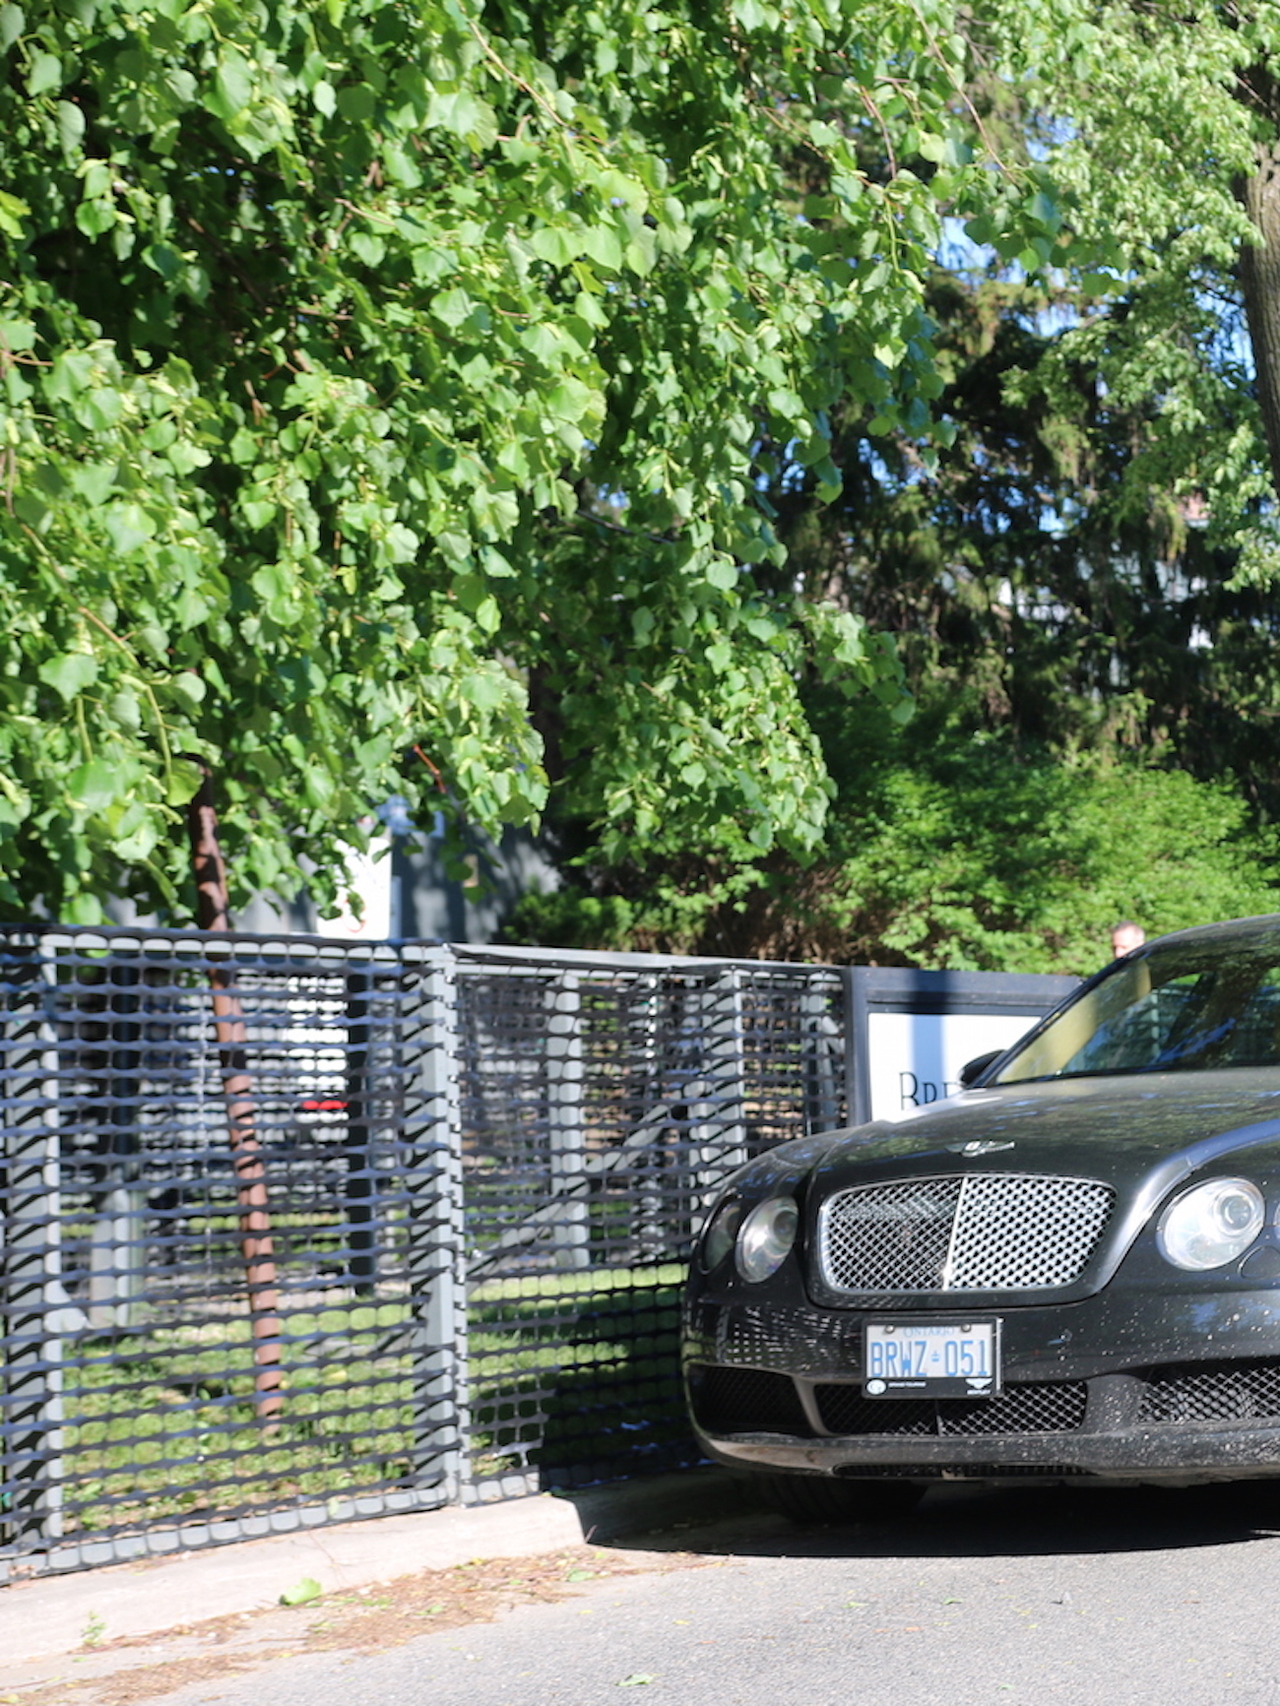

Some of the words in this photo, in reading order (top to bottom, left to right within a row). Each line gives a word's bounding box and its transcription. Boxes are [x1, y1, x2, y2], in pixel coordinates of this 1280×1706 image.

[903, 1327, 955, 1337] ONTARIO
[870, 1341, 927, 1377] BRWZ
[944, 1340, 987, 1376] 051
